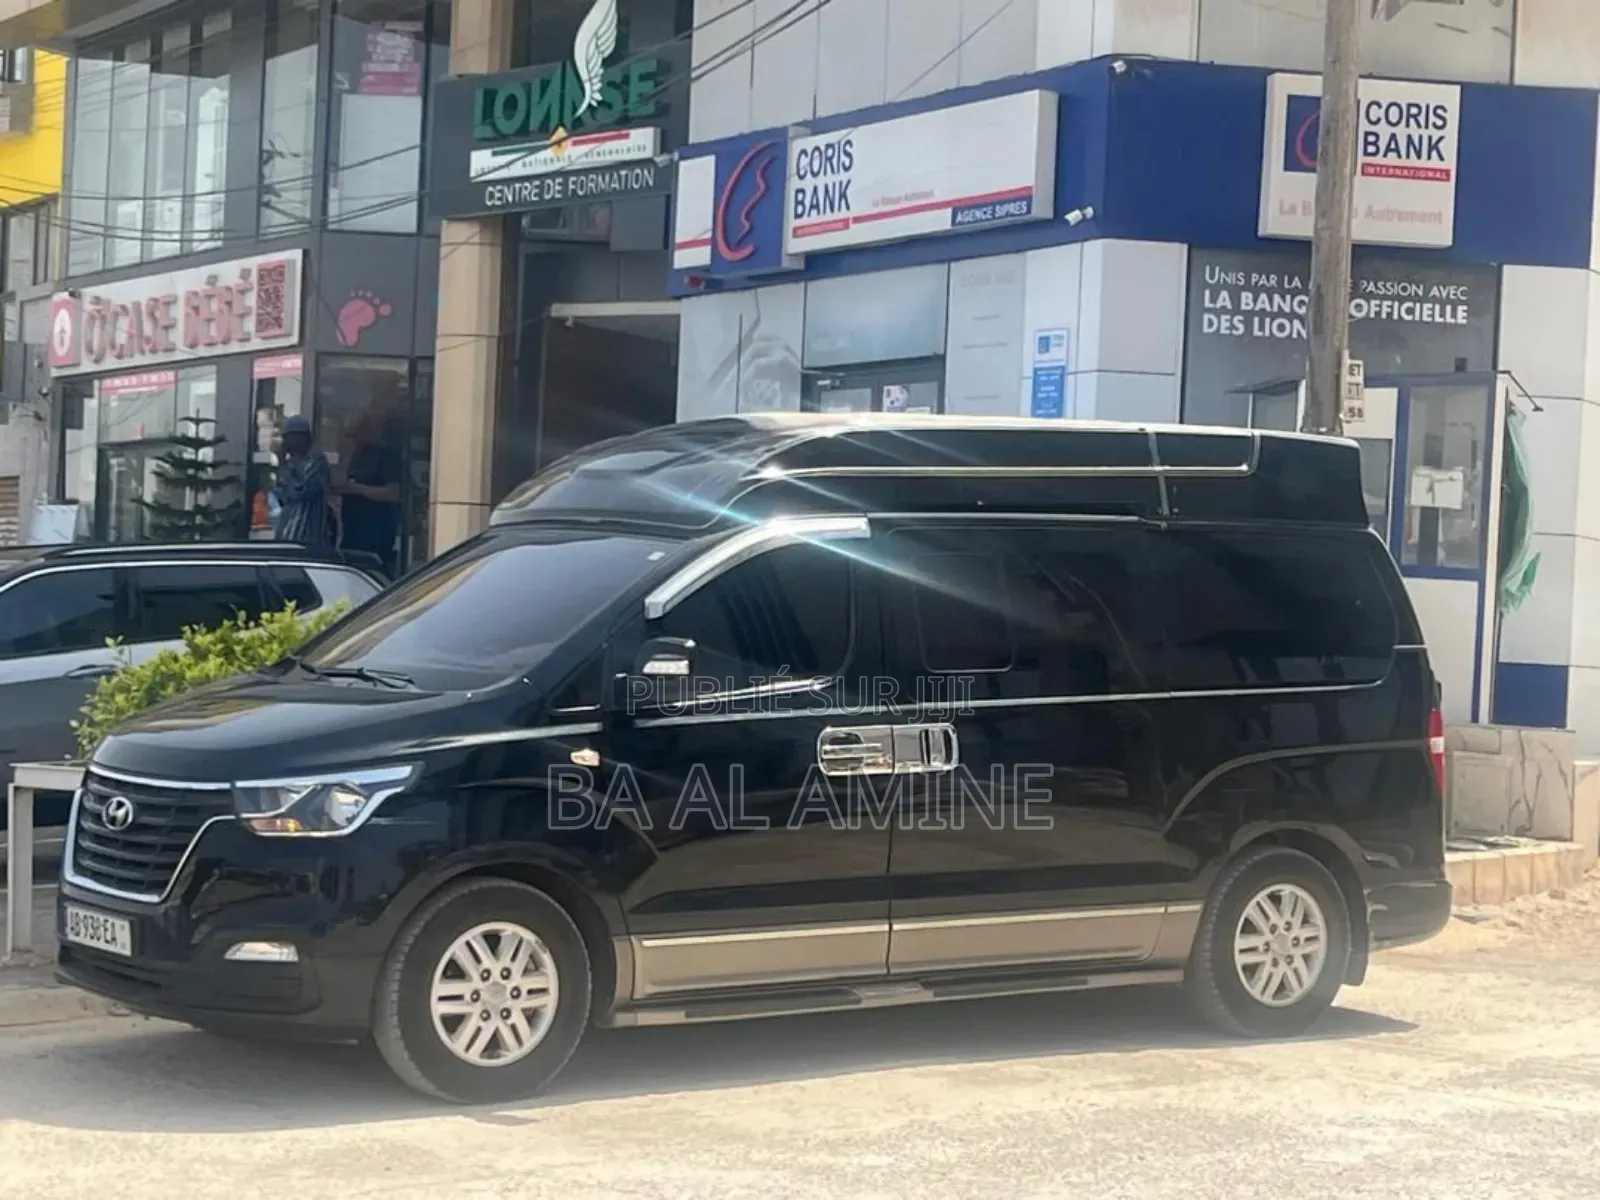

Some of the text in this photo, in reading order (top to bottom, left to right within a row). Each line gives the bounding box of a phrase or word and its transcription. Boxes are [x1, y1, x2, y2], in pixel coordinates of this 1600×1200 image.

[1365, 100, 1449, 131] CORIS
[796, 138, 854, 181] CORIS
[1362, 130, 1446, 162] BANK
[485, 166, 655, 206] CENTRE DE FORMATION
[1363, 165, 1449, 181] INTERNATIONAL
[793, 179, 852, 221] BANK
[955, 207, 993, 225] AGENCE
[1251, 273, 1278, 288] PAR
[1283, 275, 1303, 290] LA
[1429, 285, 1469, 301] AVEC
[1203, 289, 1233, 310] LA
[1349, 298, 1469, 325] OFFICIELLE
[1202, 313, 1308, 340] DES LION
